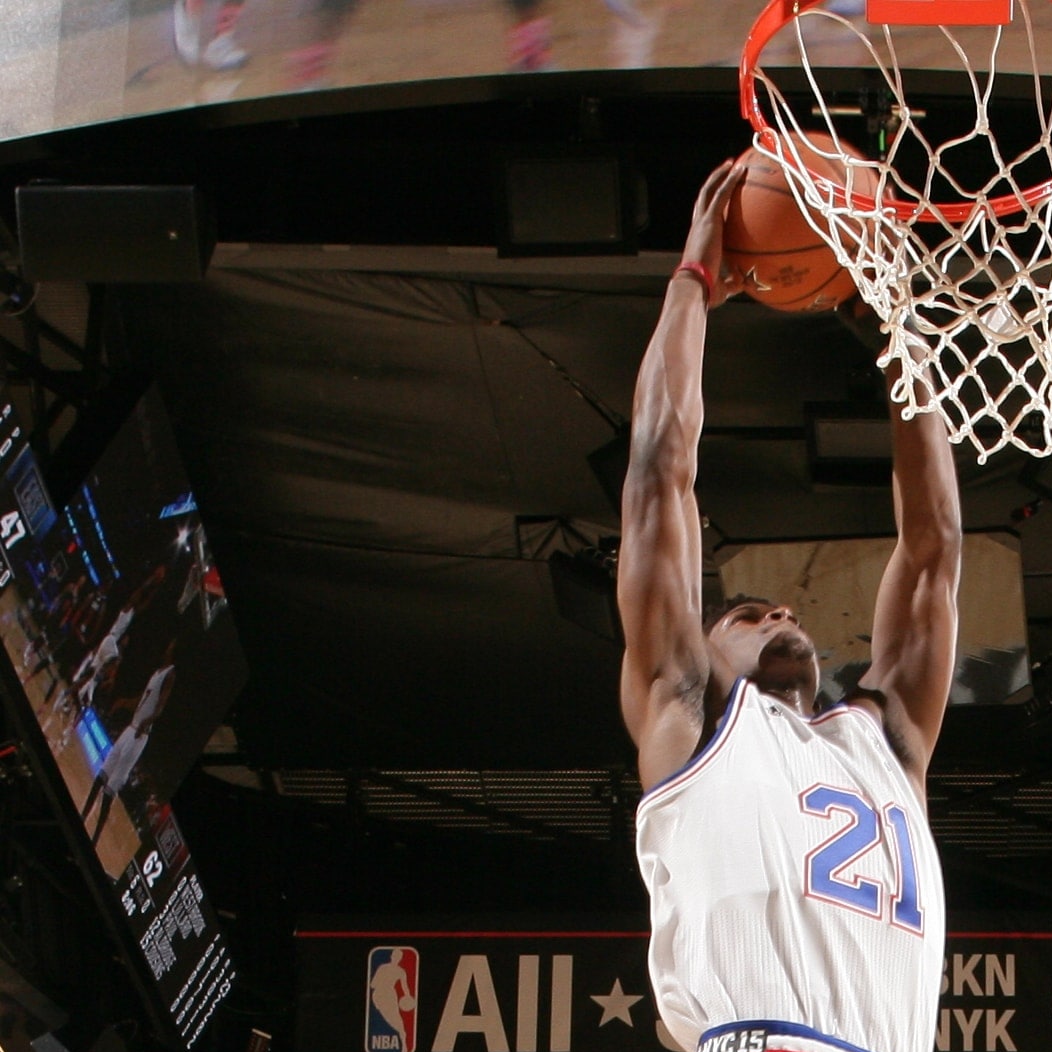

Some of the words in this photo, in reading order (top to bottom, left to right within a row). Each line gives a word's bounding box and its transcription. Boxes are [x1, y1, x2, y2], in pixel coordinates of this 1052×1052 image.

[143, 850, 163, 888] 62
[798, 782, 925, 938] 21
[942, 953, 1016, 997] KN
[431, 954, 573, 1052] All
[371, 1034, 400, 1050] NBA
